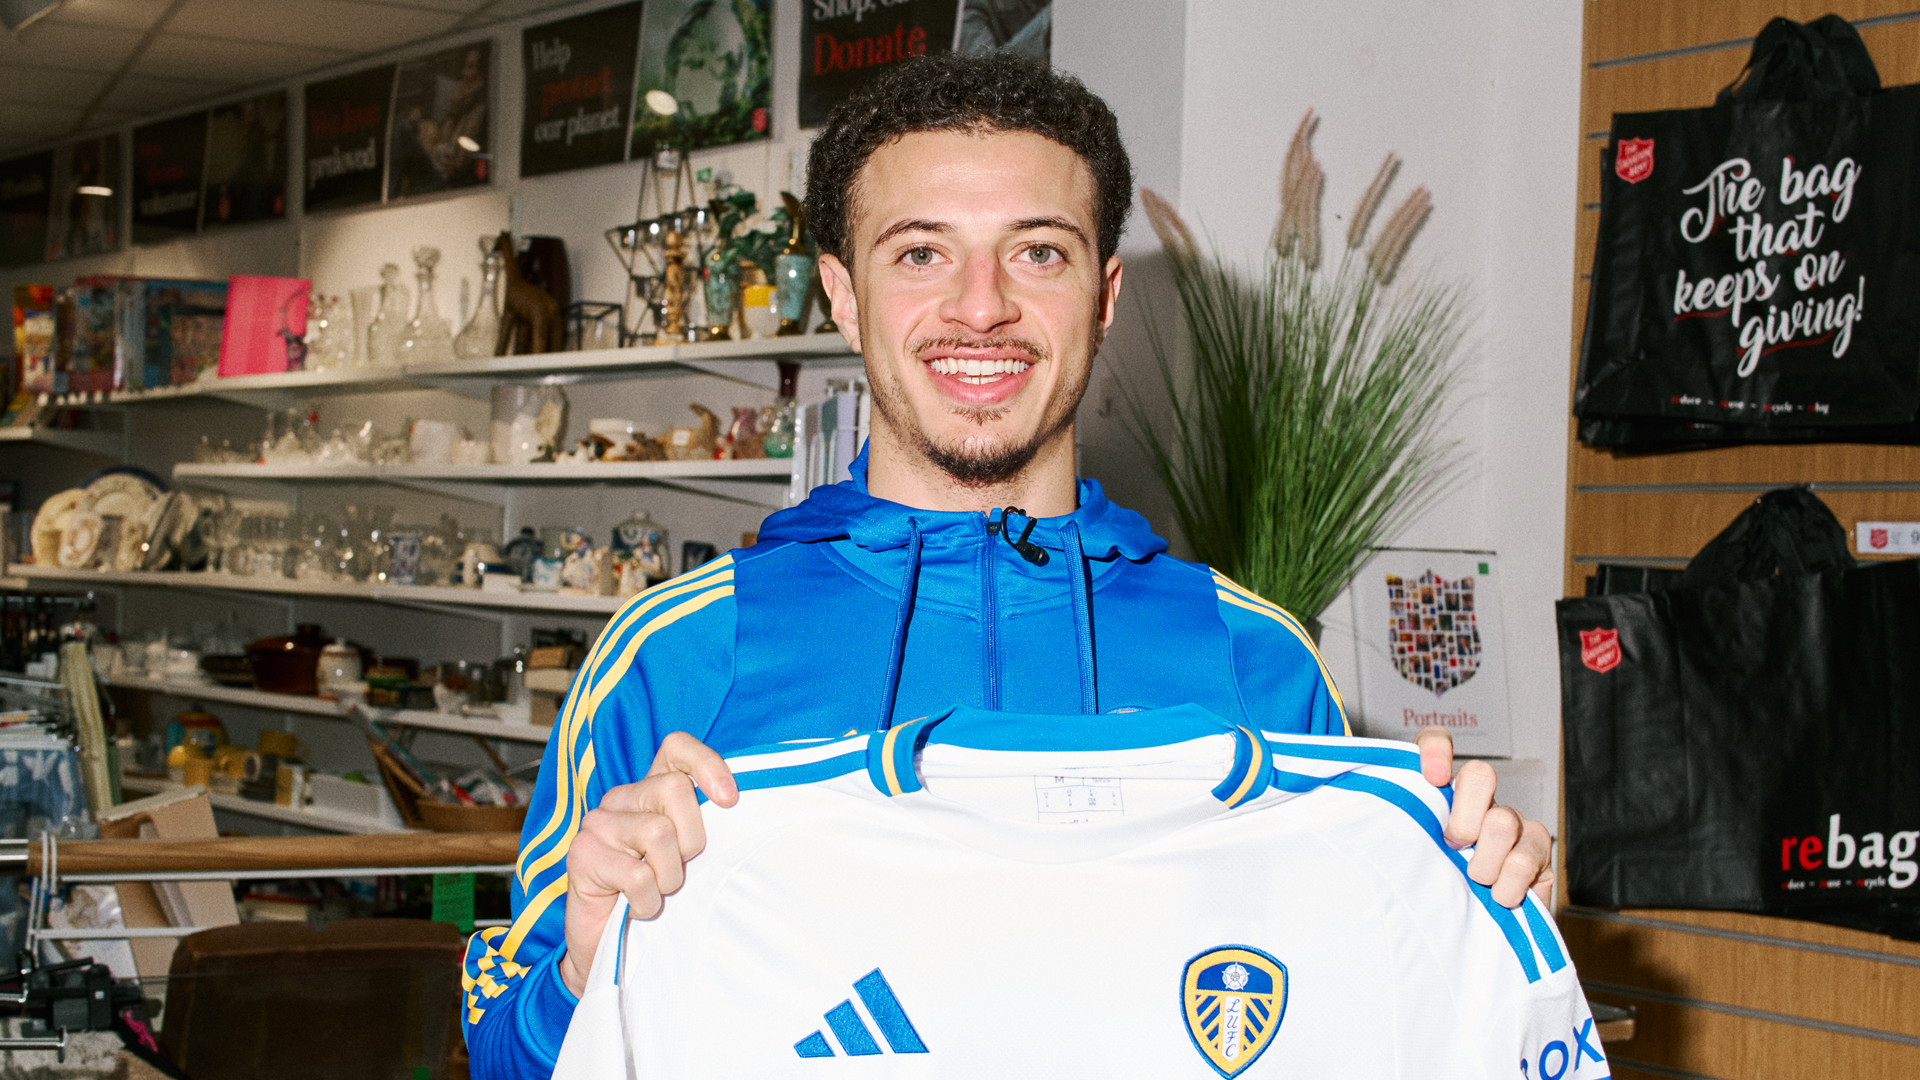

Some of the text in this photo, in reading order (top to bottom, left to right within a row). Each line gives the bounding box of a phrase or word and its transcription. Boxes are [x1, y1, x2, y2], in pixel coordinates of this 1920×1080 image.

[532, 37, 572, 75] Help
[814, 22, 928, 76] Donate
[534, 104, 620, 147] our planet
[1680, 157, 1862, 243] The bag
[1728, 202, 1825, 262] that
[1673, 250, 1847, 328] keeps on
[1737, 275, 1865, 378] giving!
[1403, 708, 1478, 728] Portraits
[1781, 813, 1920, 889] rebag
[1225, 998, 1241, 1058] LUFC
